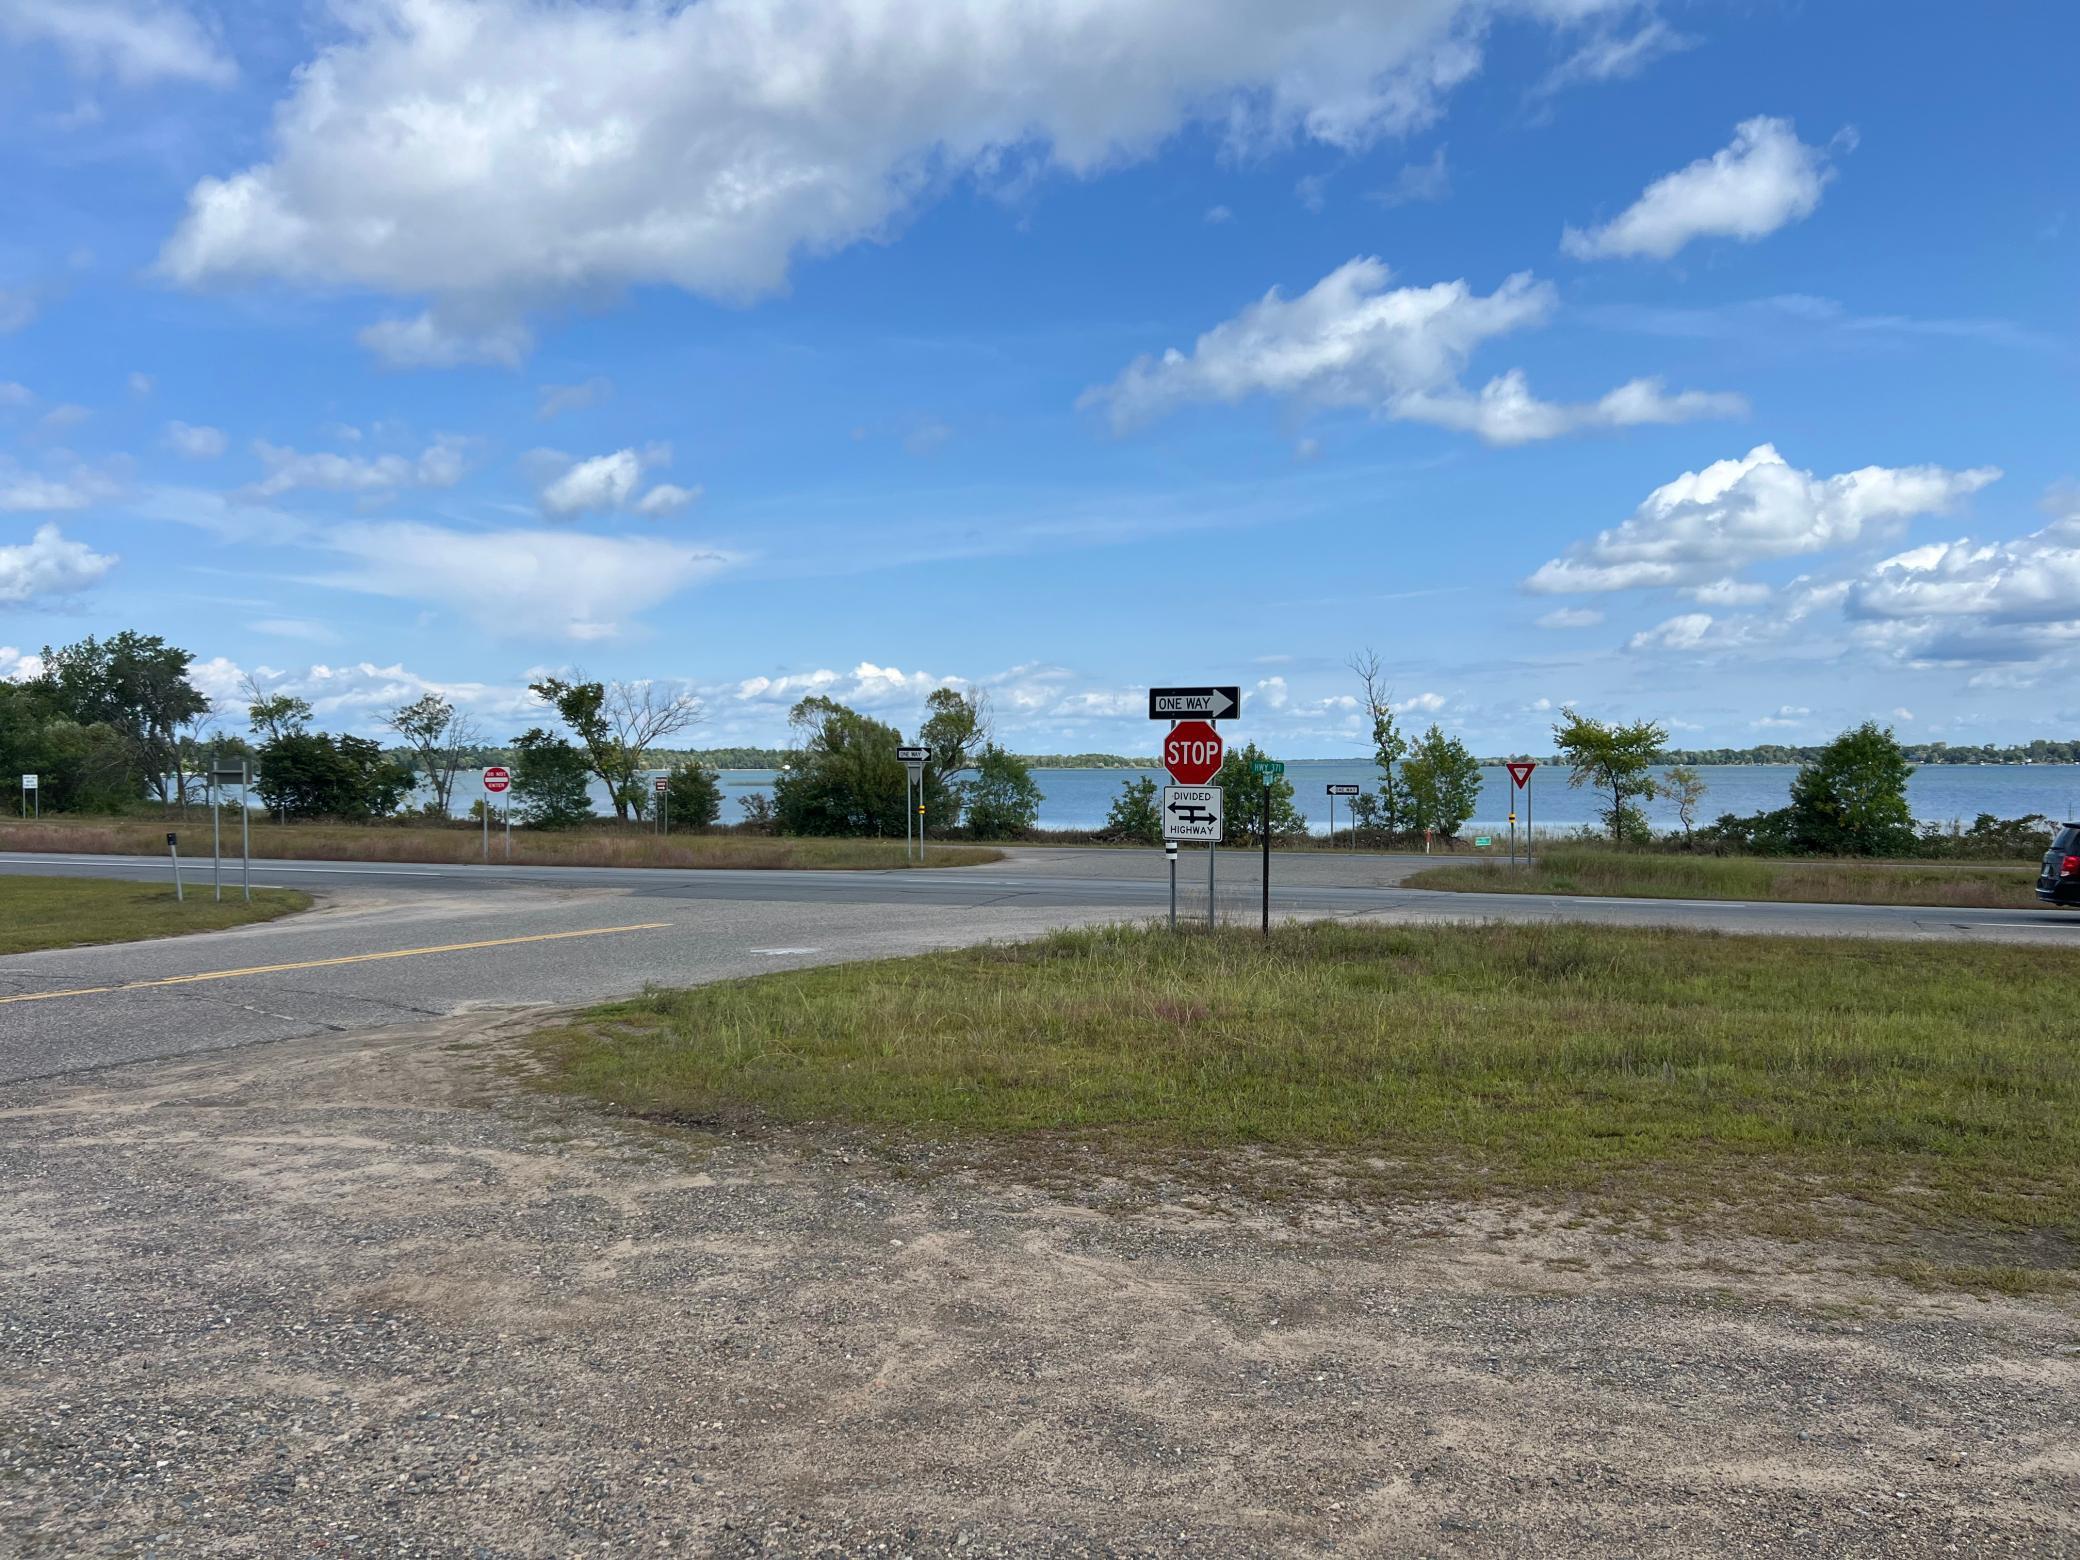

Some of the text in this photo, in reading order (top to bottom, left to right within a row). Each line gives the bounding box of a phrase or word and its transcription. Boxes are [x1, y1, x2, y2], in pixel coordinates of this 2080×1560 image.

[1158, 697, 1211, 710] ONE WAY
[1167, 740, 1219, 765] STOP
[1254, 763, 1269, 771] HWY
[1174, 792, 1211, 801] DIVIDED
[1170, 825, 1214, 835] HIGHWAY
